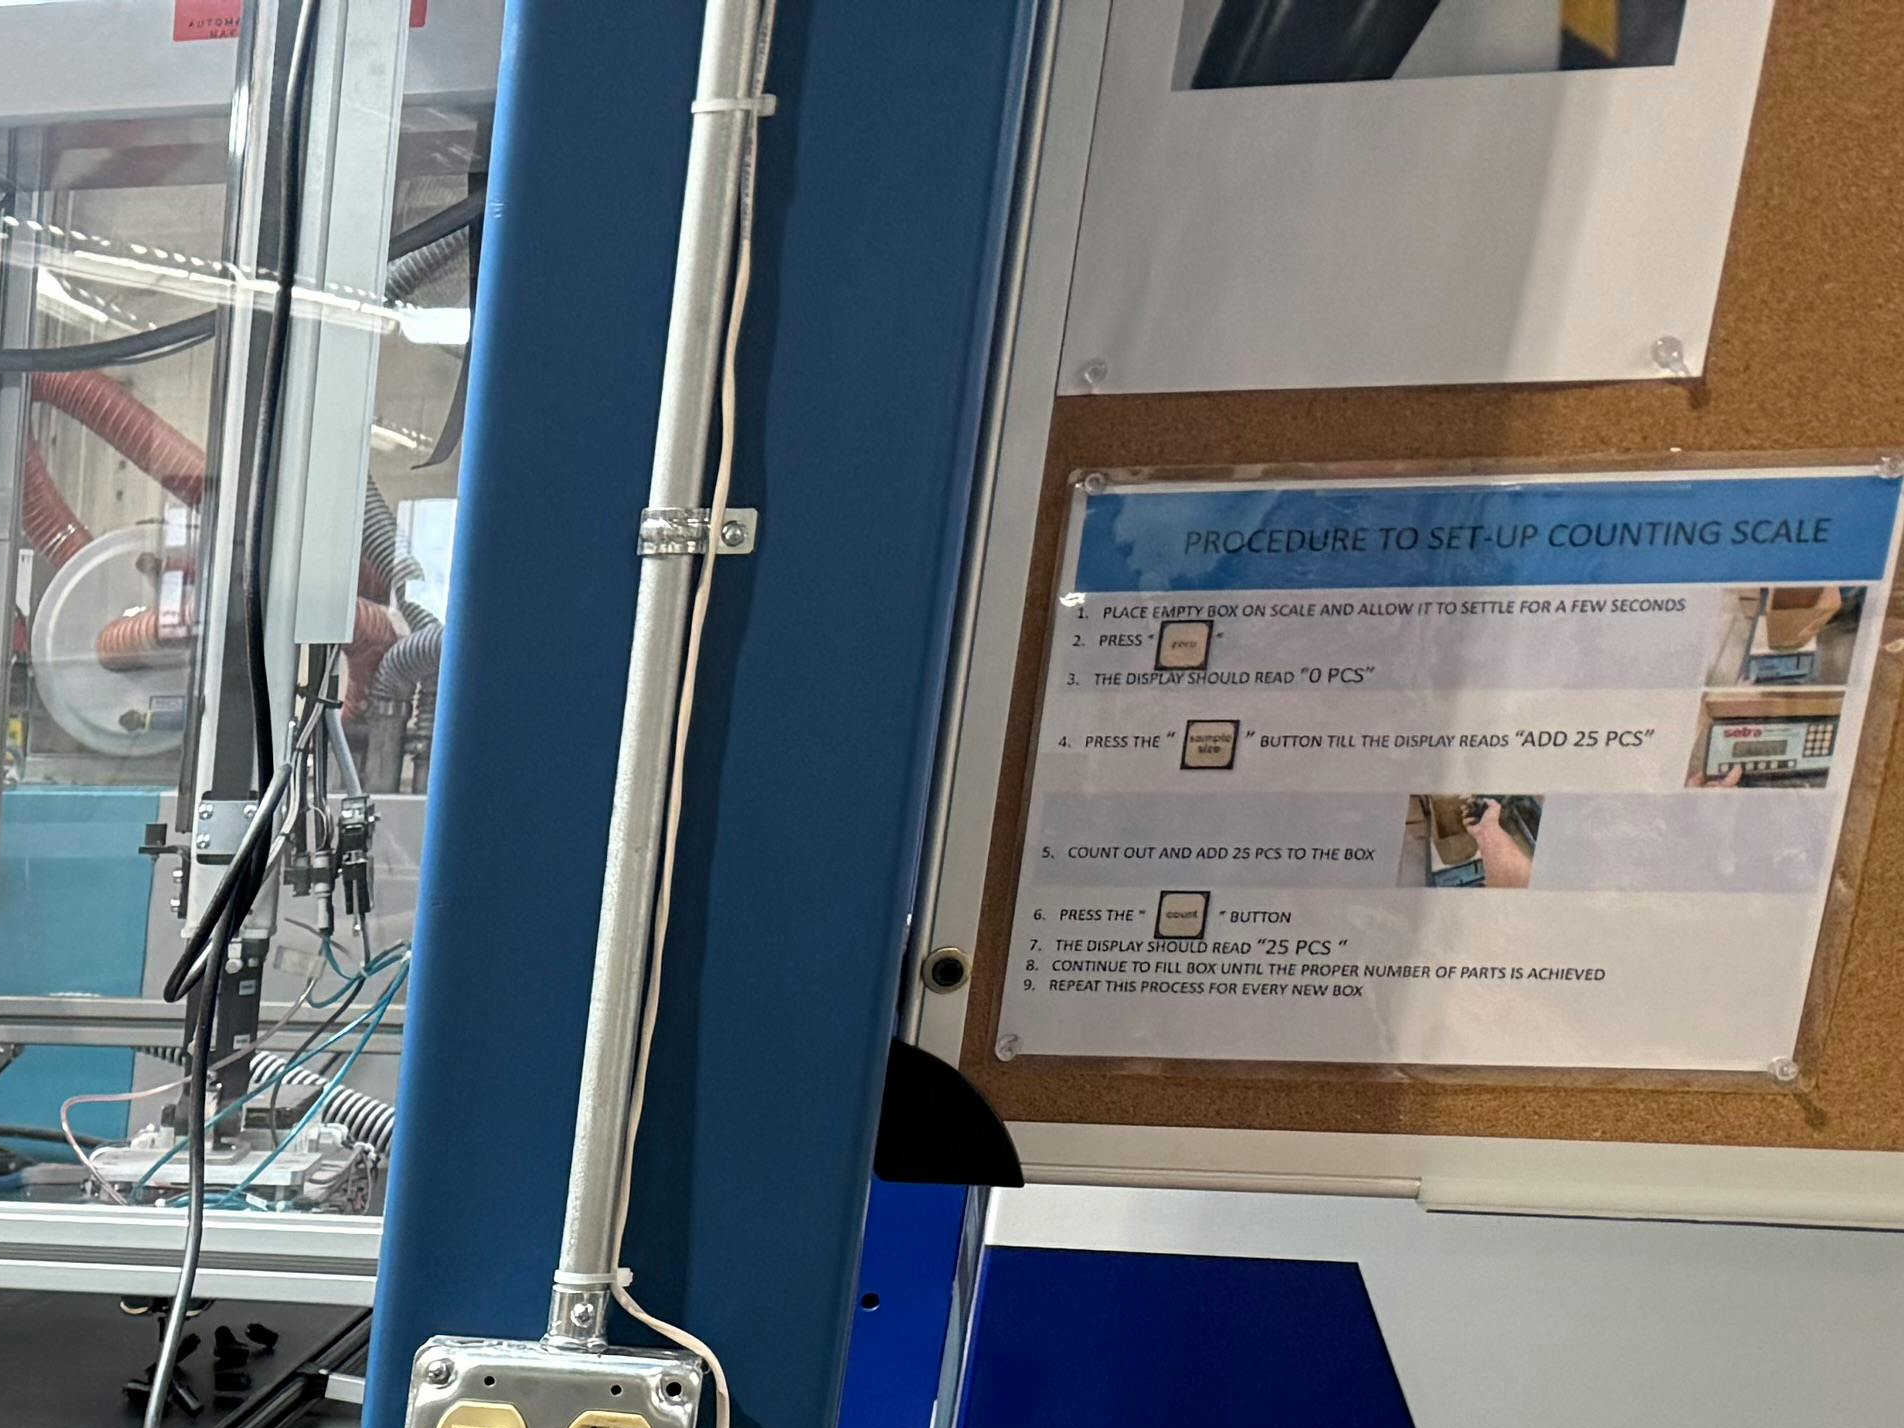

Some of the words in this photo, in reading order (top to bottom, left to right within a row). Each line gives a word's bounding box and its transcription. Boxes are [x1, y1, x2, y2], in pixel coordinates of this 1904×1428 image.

[1184, 528, 1369, 556] PROCEDURE
[1379, 527, 1419, 551] TO
[1426, 523, 1539, 551] SET-UP
[1548, 520, 1722, 548] COUNTING
[1731, 517, 1833, 545] SCALE
[1103, 606, 1148, 619] PLACE
[1152, 605, 1203, 619] EMPTY
[1208, 605, 1238, 617] BOX
[1242, 605, 1265, 617] ON
[1270, 604, 1316, 616] SCALE
[1320, 604, 1354, 616] AND
[1357, 602, 1415, 616] ALLOW
[1417, 602, 1432, 615] IT
[1436, 602, 1458, 615] TO
[1461, 601, 1515, 614] SETTLE
[1520, 600, 1552, 614] FOR
[1555, 600, 1567, 613] A
[1571, 599, 1607, 613] FEW
[1611, 598, 1686, 612] SECONDS
[1094, 673, 1122, 685] THE
[1126, 672, 1183, 685] DISPLAY
[1187, 671, 1250, 685] SHOULD
[1254, 671, 1294, 684] READ
[1085, 736, 1129, 749] PRESS
[1133, 735, 1160, 748] THE
[1259, 734, 1322, 748] BUTTON
[1328, 734, 1356, 748] TILL
[1361, 734, 1390, 748] THE
[1394, 734, 1456, 748] DISPLAY
[1459, 734, 1509, 748] READS
[1573, 730, 1598, 747] 25
[1068, 847, 1119, 859] COUNT
[1124, 847, 1157, 859] OUT
[1159, 847, 1192, 859] AND
[1195, 847, 1228, 859] ADD
[1232, 847, 1251, 859] 25
[1255, 847, 1282, 860] PCS
[1287, 848, 1307, 860] TO
[1311, 848, 1340, 861] THE
[1343, 848, 1376, 861] BOX
[1051, 960, 1128, 974] CONTINUE
[1131, 961, 1152, 974] TO
[1155, 962, 1183, 974] FILL
[1187, 962, 1217, 975] BOX
[1221, 963, 1264, 975] UNTIL
[1268, 963, 1296, 976] THE
[1301, 964, 1359, 977] PROPER
[1364, 964, 1431, 979] NUMBER
[1436, 966, 1457, 979] OF
[1460, 967, 1507, 980] PARTS
[1510, 968, 1524, 980] IS
[1527, 968, 1606, 982] ACHIEVED
